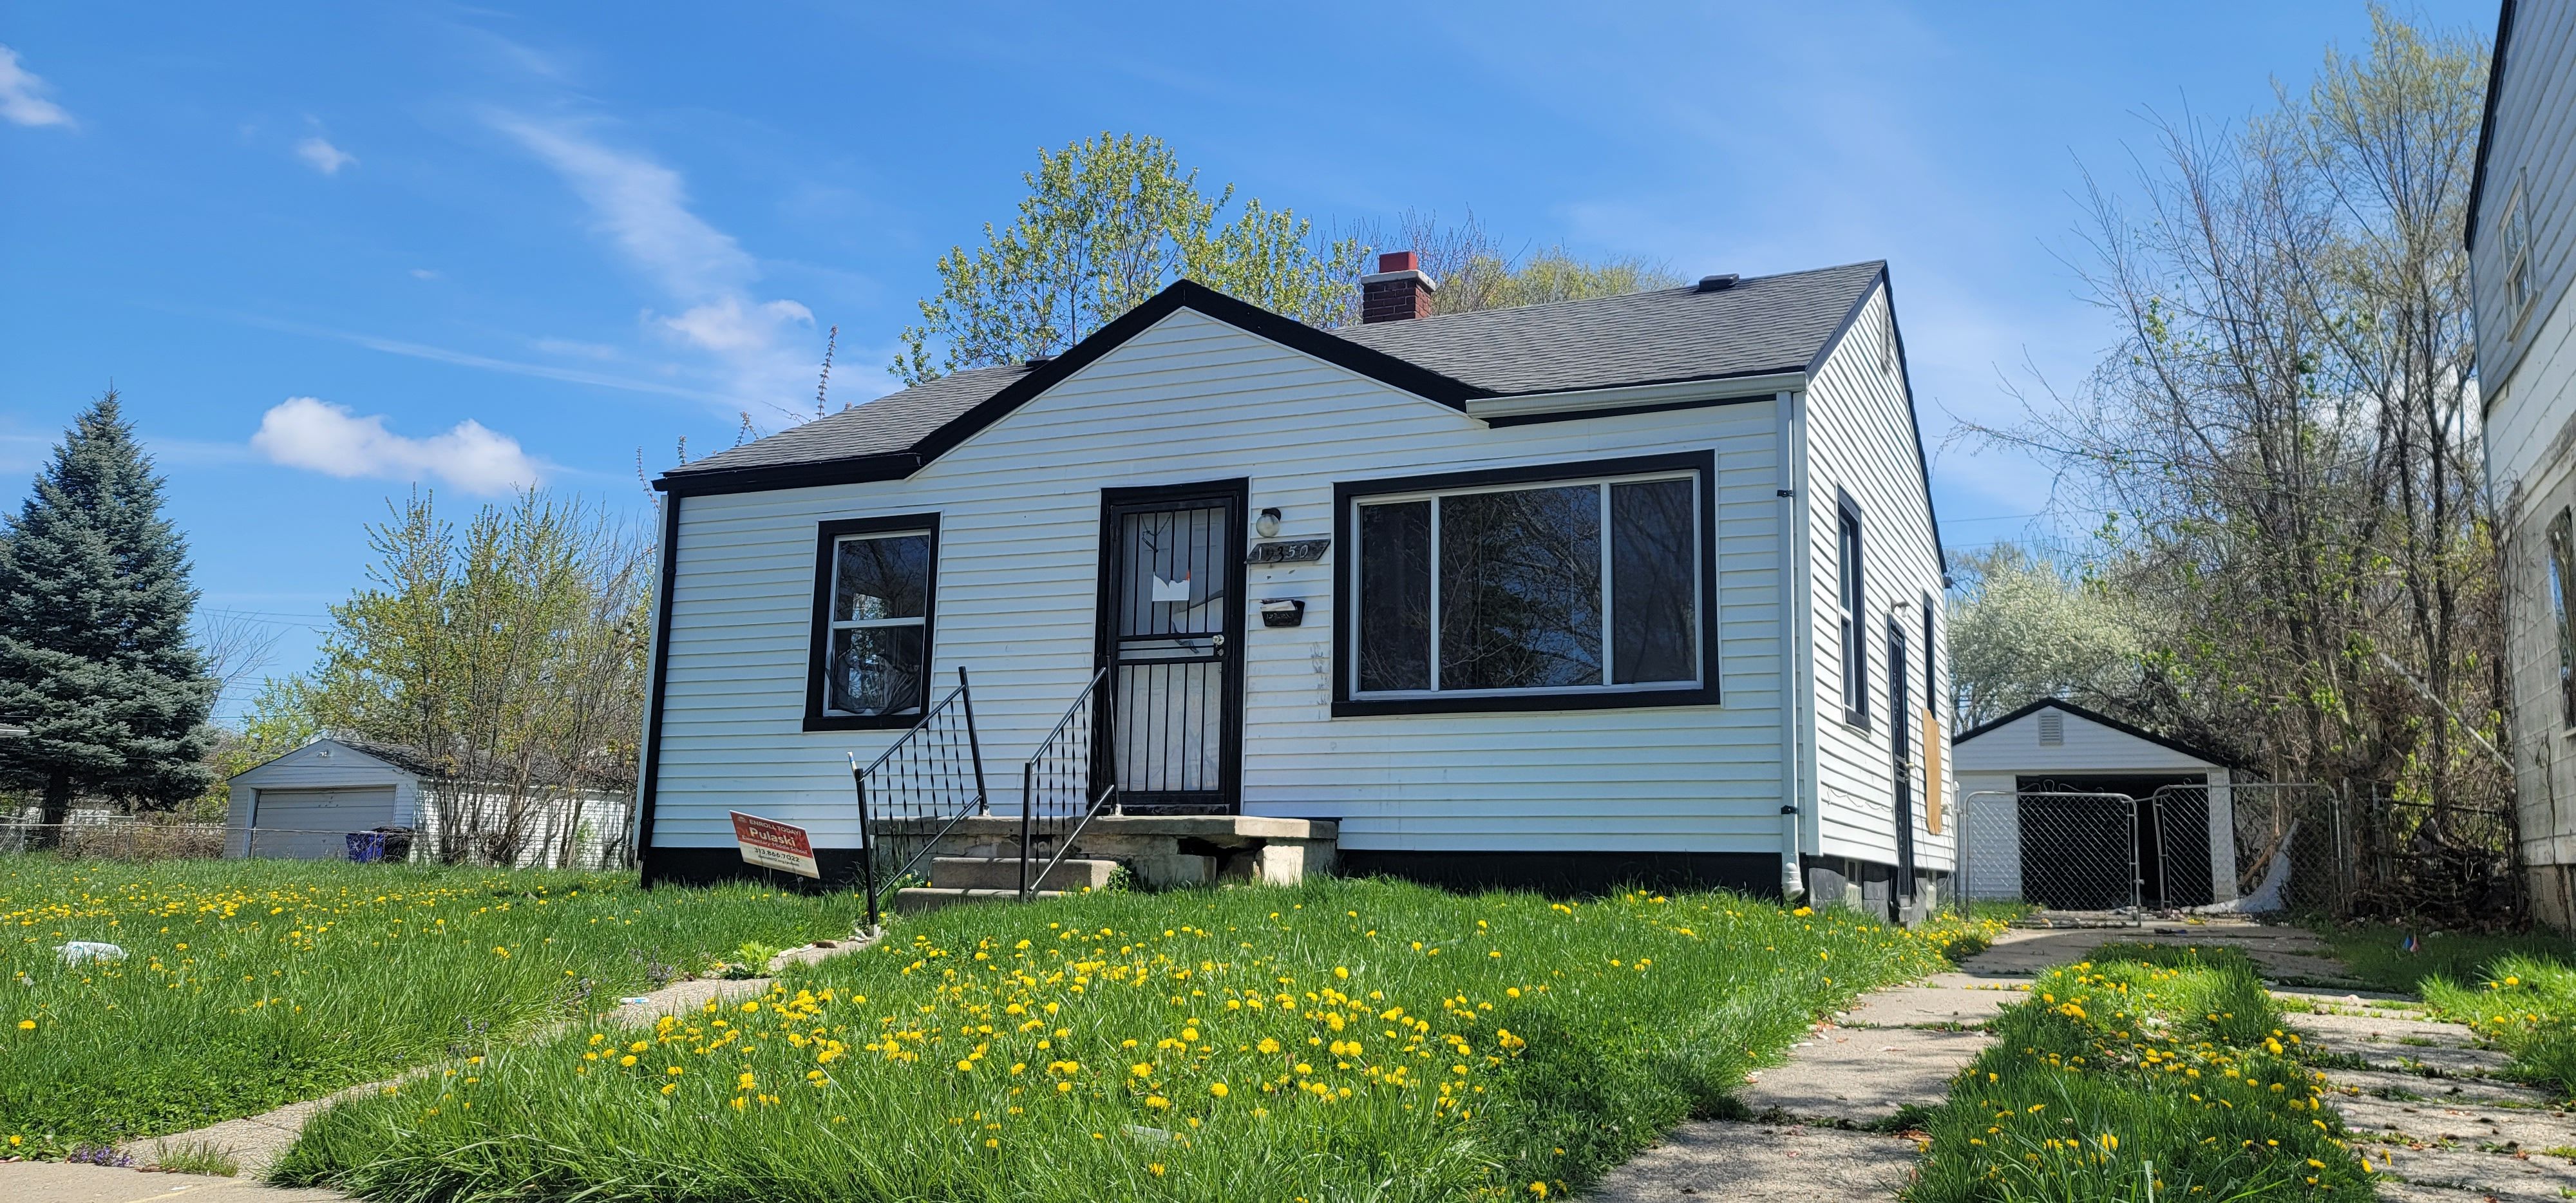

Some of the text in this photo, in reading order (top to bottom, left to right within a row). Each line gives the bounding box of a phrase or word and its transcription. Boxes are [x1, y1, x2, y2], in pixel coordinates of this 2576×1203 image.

[749, 819, 801, 837] ENROLL TODAY!
[749, 827, 796, 847] Pulaski
[753, 847, 800, 862] 313.866.7022
